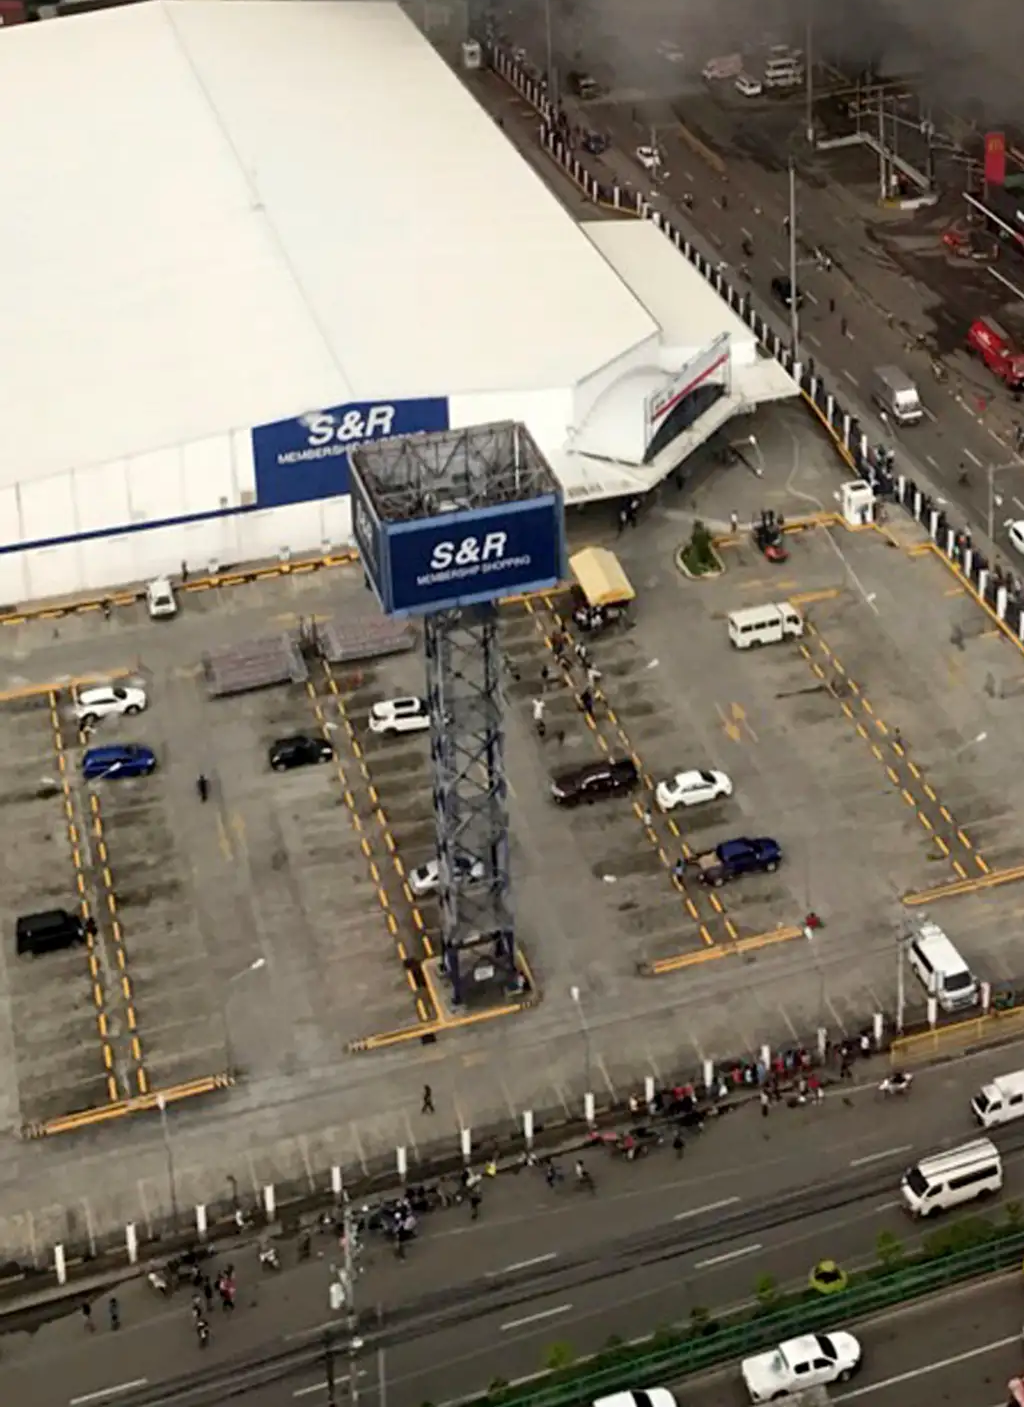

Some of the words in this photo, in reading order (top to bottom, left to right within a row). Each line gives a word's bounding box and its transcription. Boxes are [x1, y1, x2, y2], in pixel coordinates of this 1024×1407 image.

[308, 404, 396, 446] S&R
[416, 564, 480, 586] MEMBERSHIP
[482, 554, 531, 574] SHOPPING
[430, 531, 508, 570] S&R
